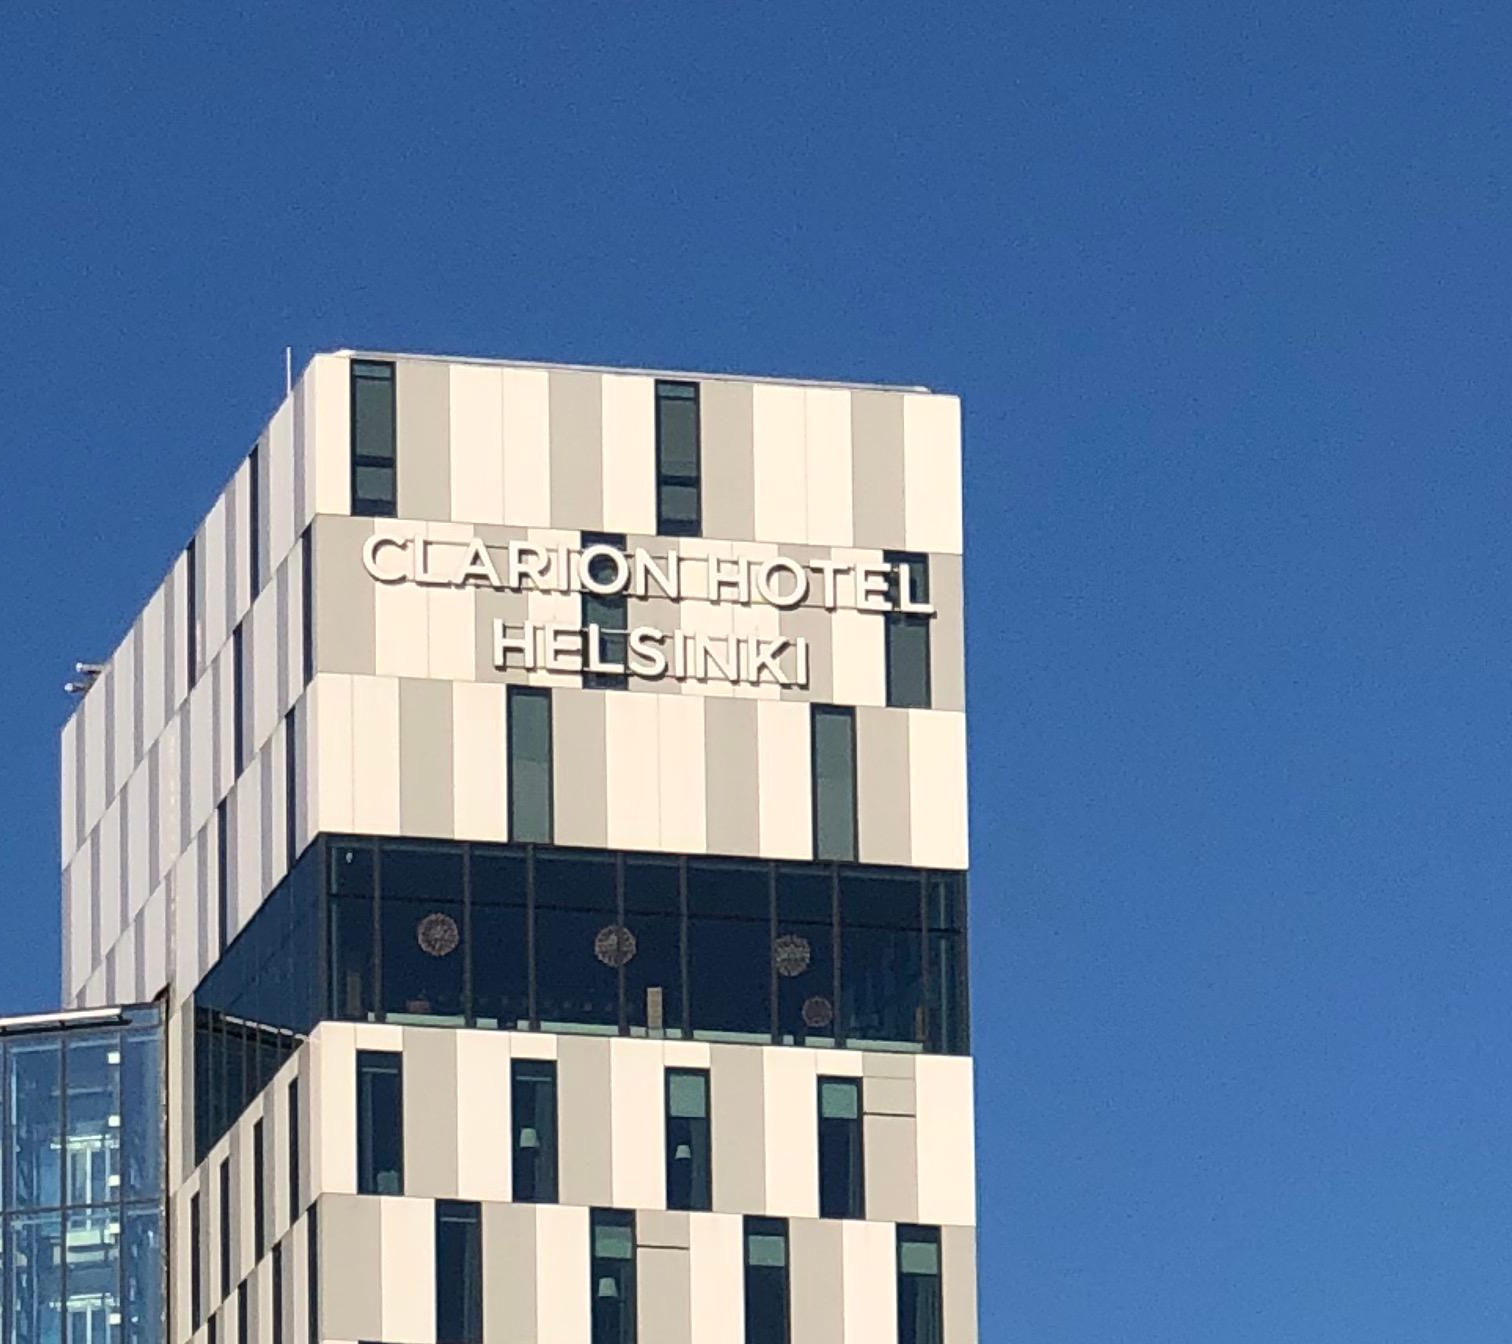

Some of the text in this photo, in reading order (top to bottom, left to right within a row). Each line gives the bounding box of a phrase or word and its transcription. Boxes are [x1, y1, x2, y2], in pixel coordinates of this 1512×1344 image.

[362, 533, 936, 615] CLARION HOTEL
[493, 617, 808, 687] HELSINKI
